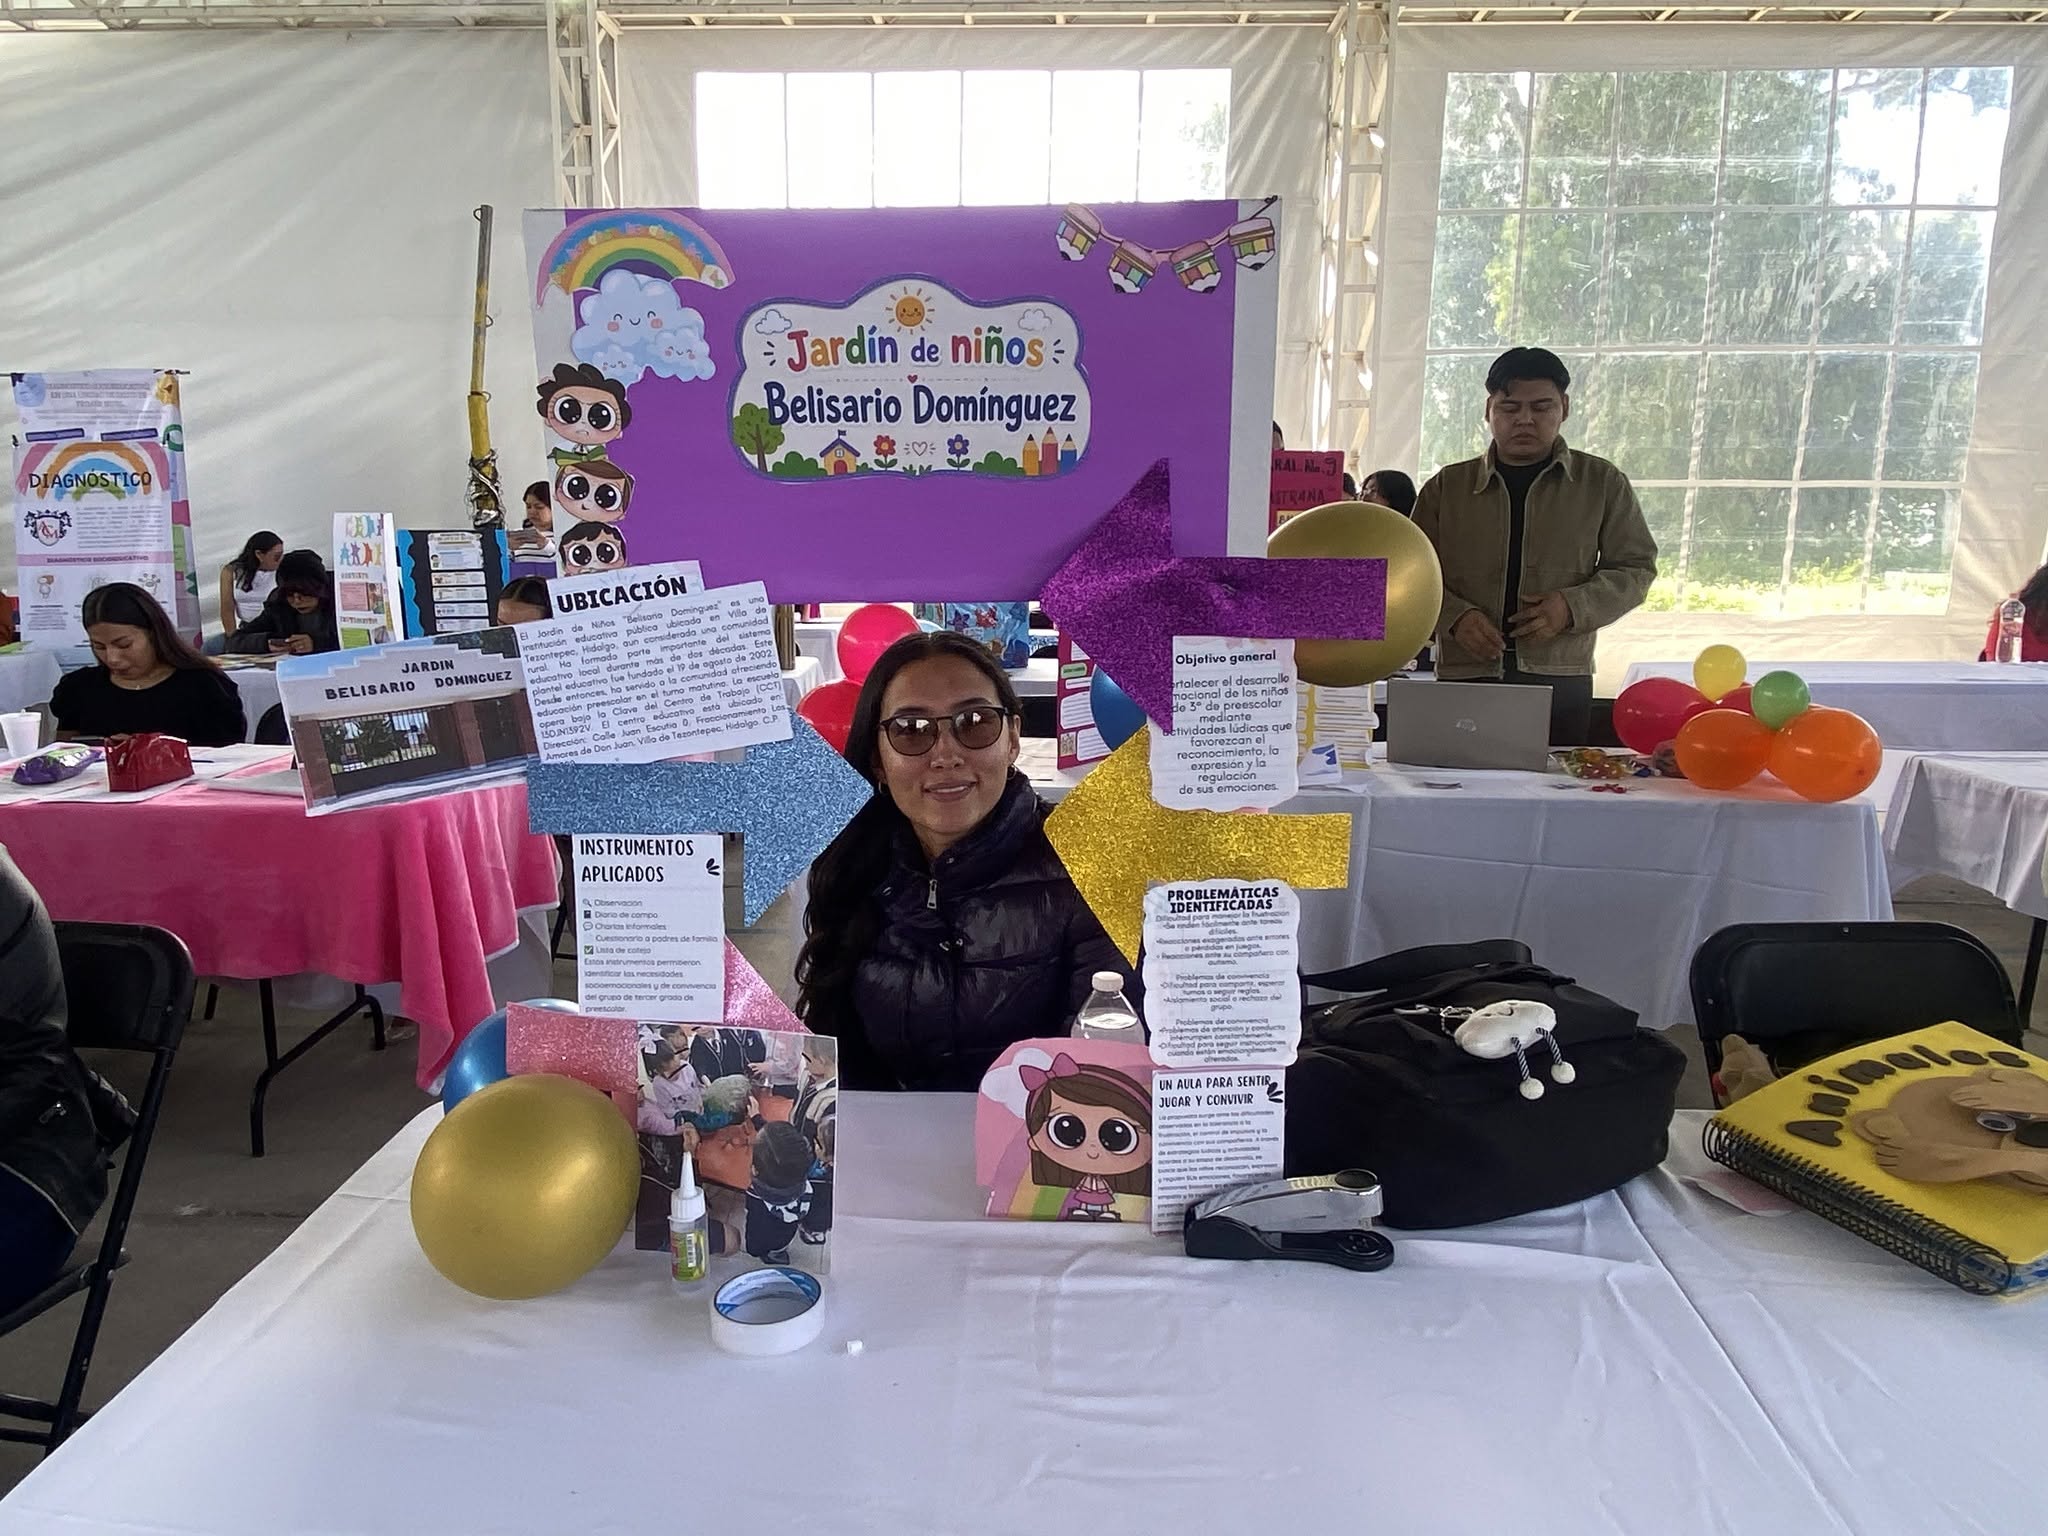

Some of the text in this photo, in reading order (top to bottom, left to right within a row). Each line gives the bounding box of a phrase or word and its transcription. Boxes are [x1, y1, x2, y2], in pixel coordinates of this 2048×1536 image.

[787, 325, 1044, 372] Jardín de niños
[764, 382, 1076, 432] Belisario Domínguez
[29, 468, 152, 489] DIAGNÓSTICO
[556, 575, 687, 612] UBICACIÓN
[1175, 649, 1276, 667] Objetivo general
[401, 659, 454, 674] JARDIN
[325, 671, 512, 700] BELISARIO DOMINGUEZ
[1222, 675, 1232, 686] el
[1235, 673, 1289, 686] desarrollo
[1224, 688, 1239, 698] de
[1242, 686, 1257, 697] los
[1261, 686, 1288, 696] niños
[1205, 700, 1220, 711] de
[1223, 697, 1282, 713] preescolar
[1199, 711, 1251, 723] mediante
[1271, 723, 1292, 734] que
[1190, 733, 1265, 747] favorezcan el
[1269, 745, 1279, 755] la
[1245, 761, 1253, 771] y
[1256, 757, 1266, 767] la
[1179, 784, 1193, 794] de
[580, 838, 695, 856] INSTRUMENTOS
[580, 865, 664, 882] APLICADOS
[1167, 886, 1279, 902] PROBLEMÁTICAS
[1169, 898, 1272, 913] IDENTIFICADAS
[1159, 1080, 1172, 1091] UN
[1177, 1078, 1202, 1090] AULA
[1206, 1077, 1233, 1088] PARA
[1159, 1093, 1253, 1108] JUGAR Y CONVIVIR
